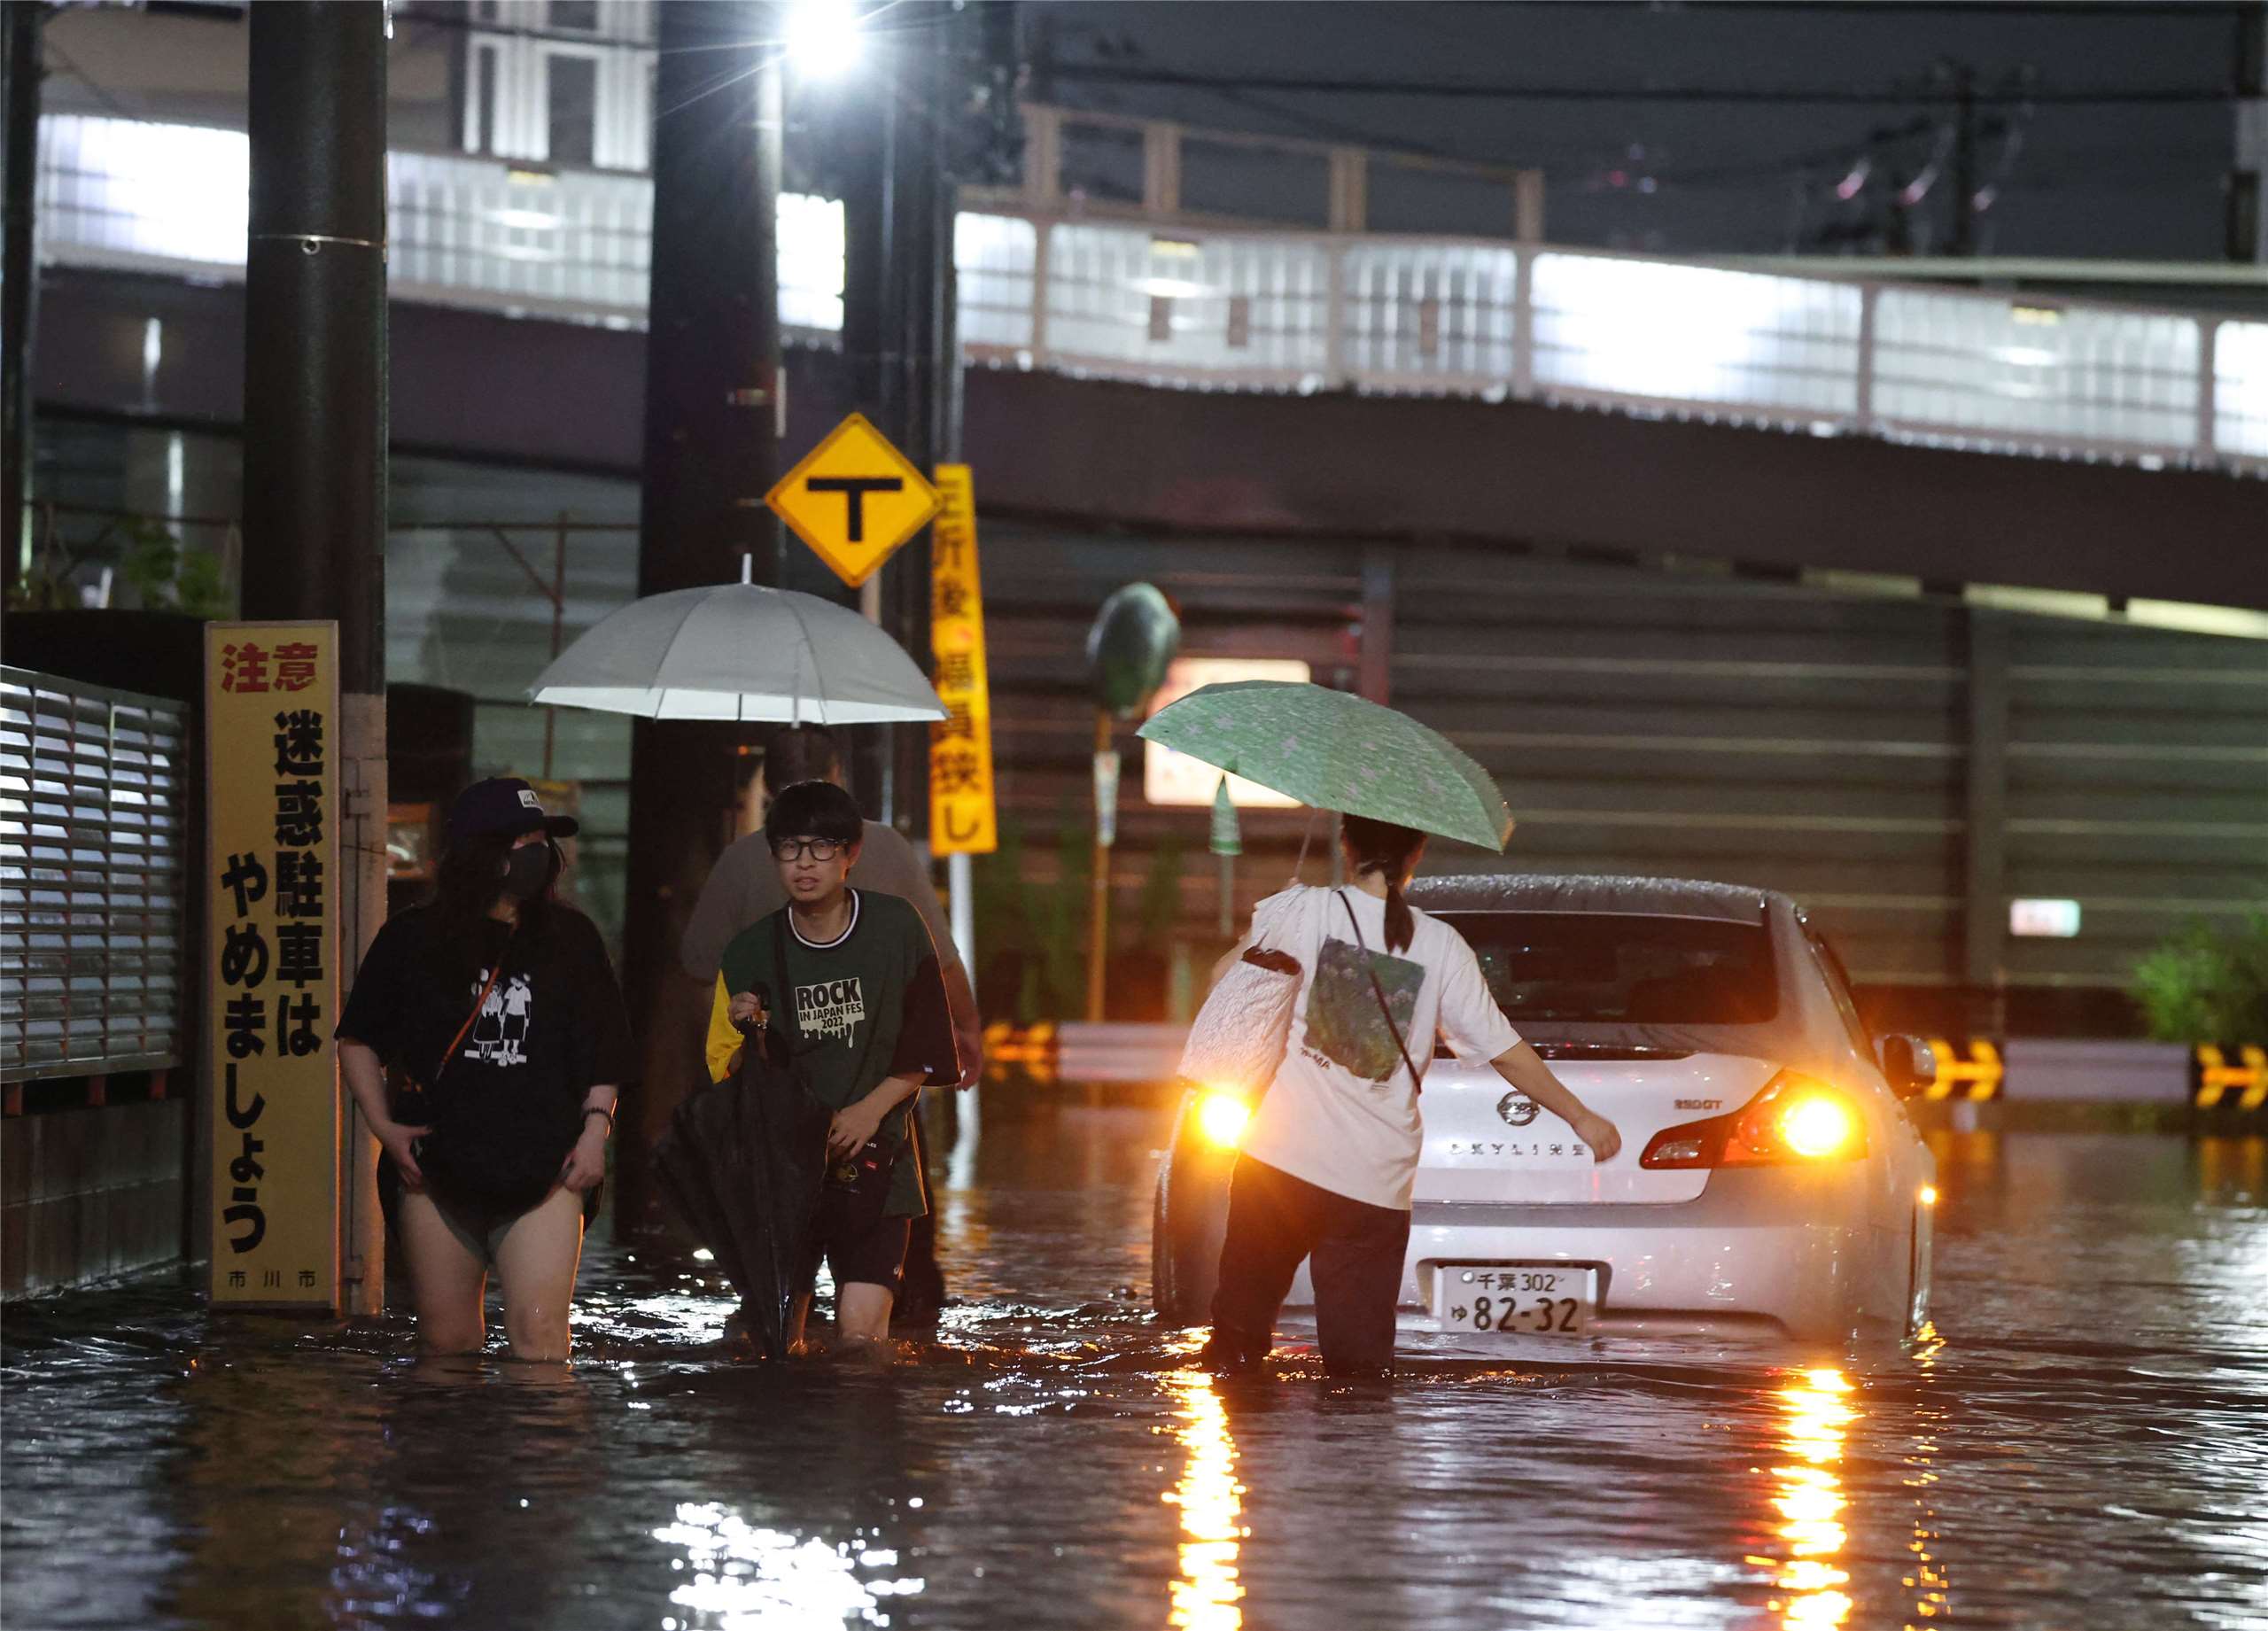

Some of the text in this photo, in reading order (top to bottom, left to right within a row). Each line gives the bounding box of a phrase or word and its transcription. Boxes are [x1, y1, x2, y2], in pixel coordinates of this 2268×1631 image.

[221, 642, 317, 693] 注意
[274, 710, 323, 1056] 迷惑駐車は
[797, 979, 860, 1010] ROCK
[799, 1011, 811, 1022] IN
[813, 1006, 843, 1020] JAPAN
[822, 1016, 843, 1029] 2022
[221, 850, 268, 1254] やめましょう
[1450, 1143, 1585, 1156] SKYLINE
[228, 1270, 316, 1289] 市川市
[1477, 1273, 1556, 1292] 千葉 302
[1473, 1296, 1577, 1332] 82-32
